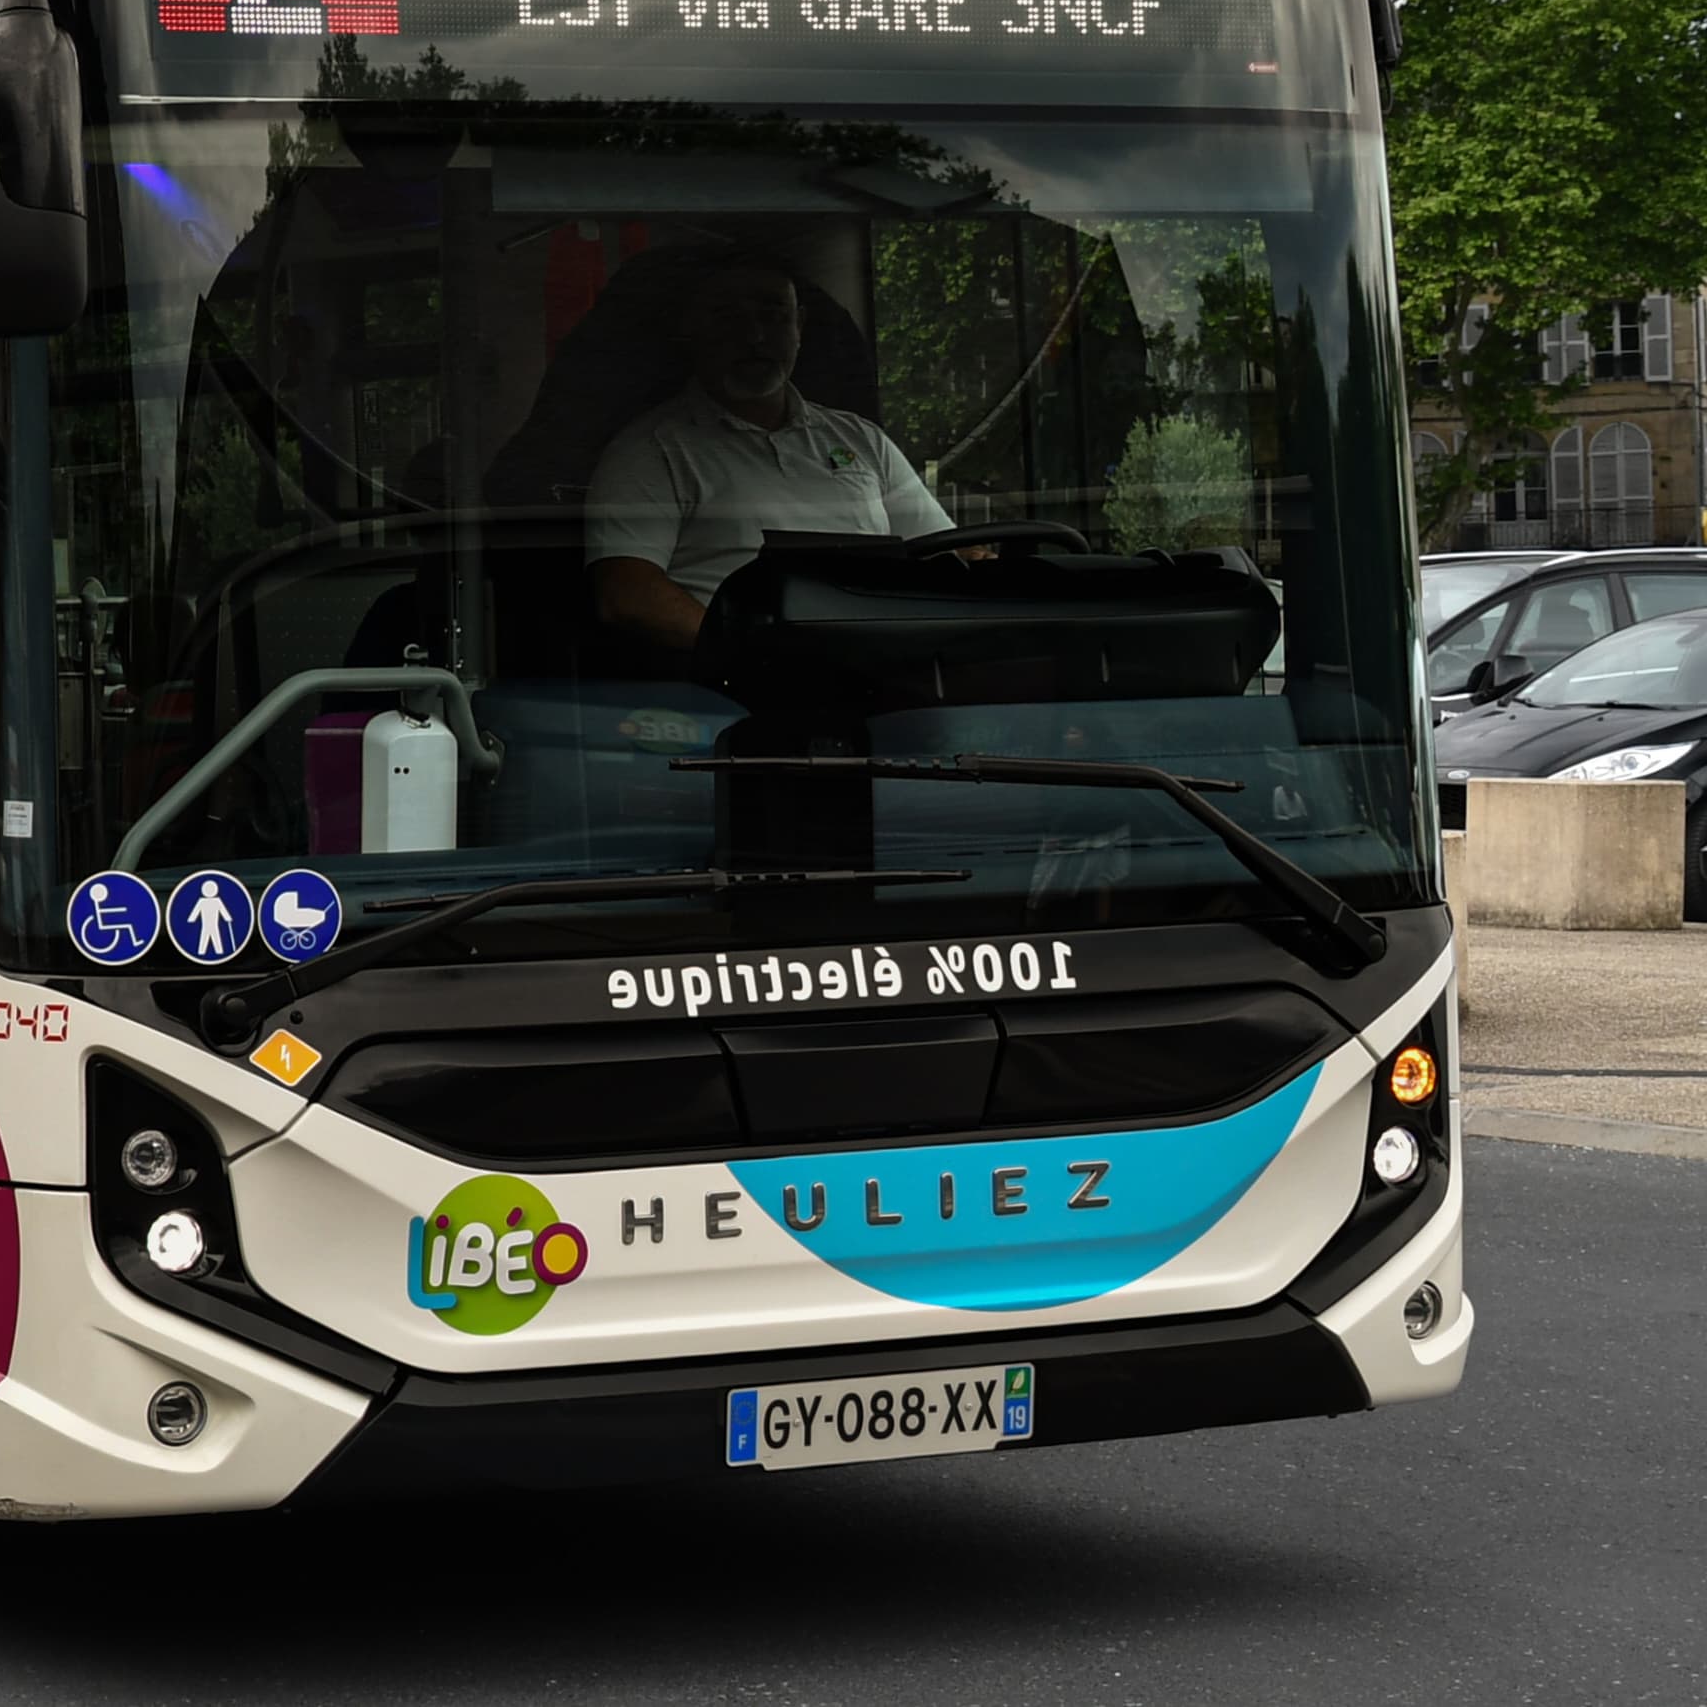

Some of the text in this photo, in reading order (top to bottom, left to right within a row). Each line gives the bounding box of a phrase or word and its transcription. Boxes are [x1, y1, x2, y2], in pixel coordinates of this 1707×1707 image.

[619, 1161, 1111, 1247] HEULIEZ
[763, 1379, 998, 1450] GY-088-XX
[1007, 1404, 1027, 1431] 19
[738, 1433, 748, 1450] F
